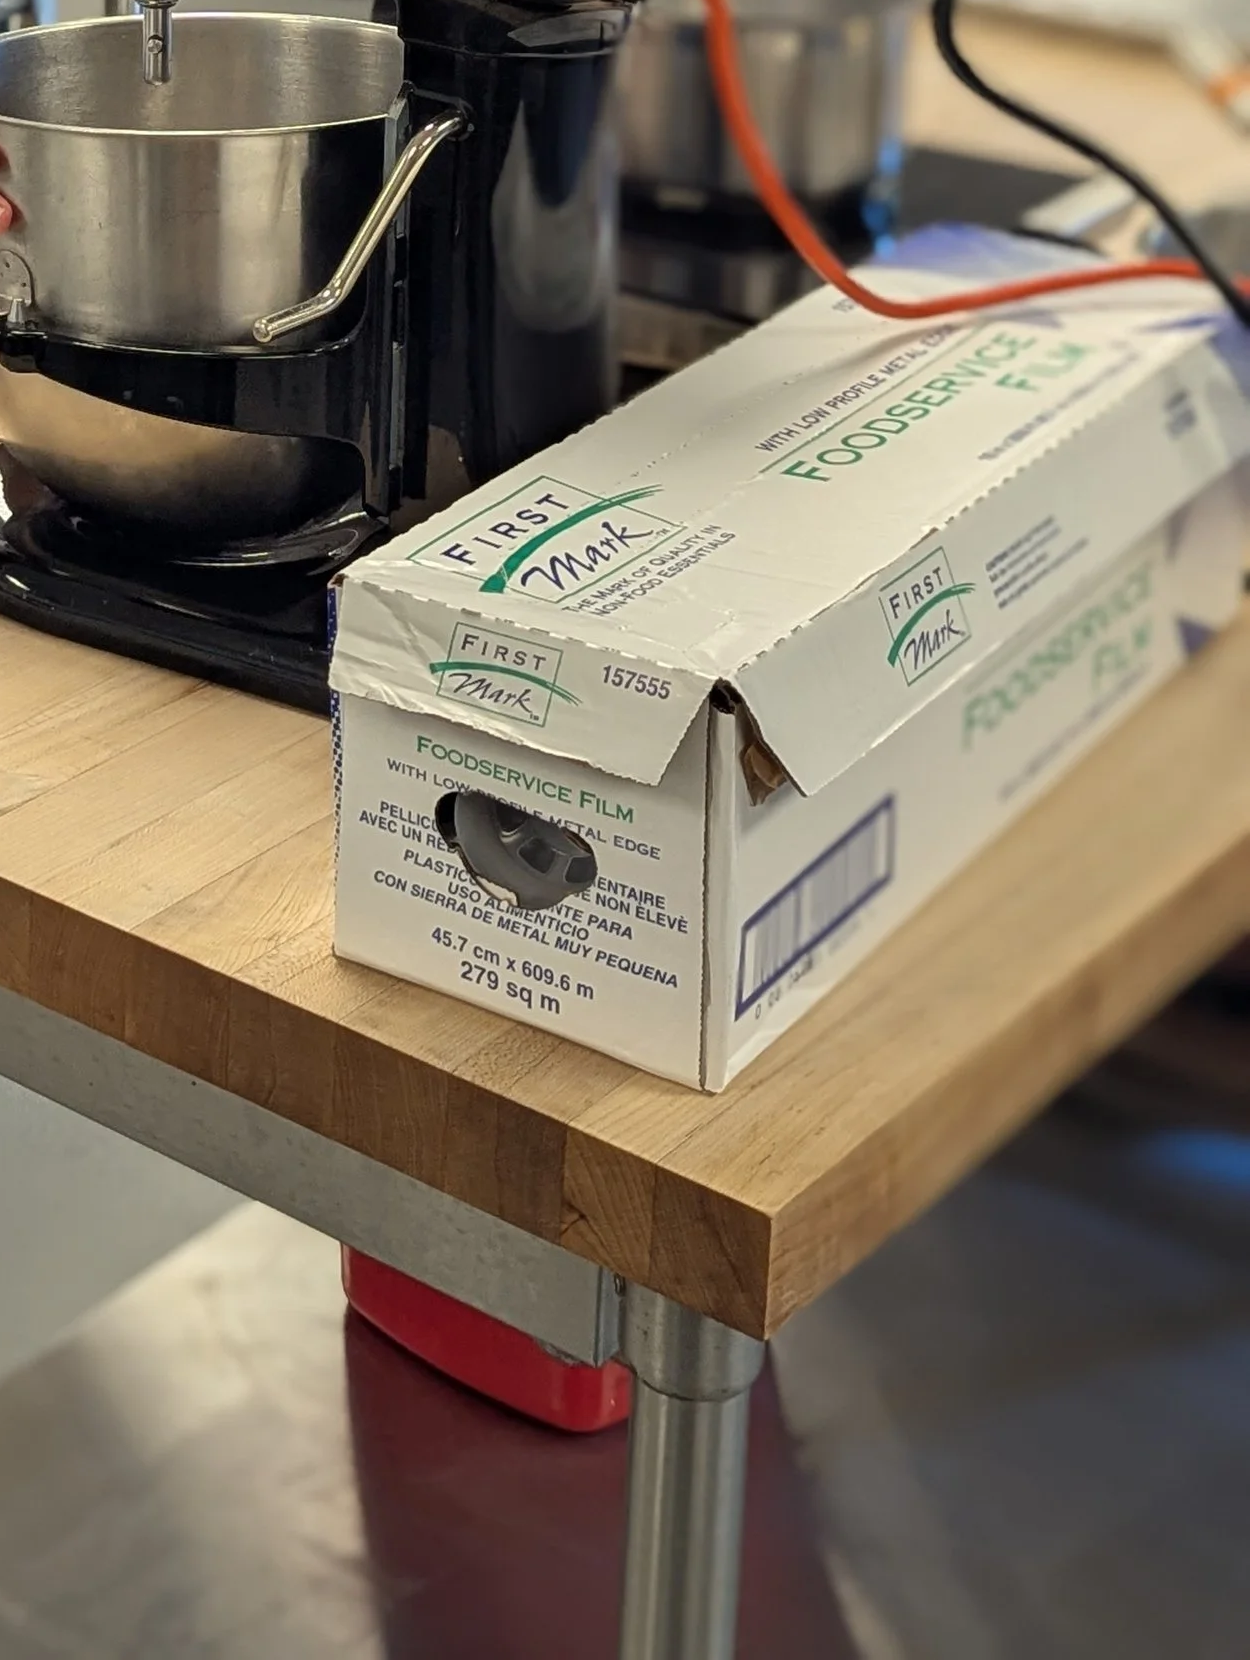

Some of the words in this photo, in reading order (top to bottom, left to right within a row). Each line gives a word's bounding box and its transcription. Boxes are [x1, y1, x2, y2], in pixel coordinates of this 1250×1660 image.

[754, 427, 801, 453] WITH
[792, 406, 822, 430] LOW
[825, 374, 887, 410] PROFILE
[879, 348, 929, 377] METAL
[780, 334, 1037, 482] FOODSERVICE
[440, 493, 569, 566] FIRST
[520, 521, 654, 591] Mark
[562, 597, 596, 613] THE
[590, 576, 635, 604] MARK
[631, 565, 652, 578] OF
[649, 534, 702, 567] QUALITY
[701, 524, 722, 535] IN
[592, 577, 664, 617] NON-FOOD
[658, 532, 736, 579] ESSENTIALS
[889, 566, 943, 619] FIRST
[461, 634, 546, 671] FIRST
[904, 609, 961, 670] Mark
[448, 673, 533, 714] Mark
[603, 664, 672, 700] 157555
[387, 758, 427, 782] WITH
[613, 836, 661, 860] EDGE
[417, 735, 572, 804] FOODSERVICE
[579, 790, 634, 824] FILM
[359, 810, 398, 834] AVEC
[401, 826, 422, 844] UN
[595, 893, 631, 916] NON
[592, 875, 666, 910] ENTAIRE
[374, 870, 408, 893] CON
[410, 884, 468, 916] SIERRA
[471, 907, 493, 925] DE
[497, 916, 551, 946] METAL
[554, 936, 594, 960] MUY
[595, 950, 679, 989] PEQUENA
[447, 882, 482, 903] USO
[484, 895, 590, 942] ALIMENTICIO
[550, 904, 585, 923] NTE
[587, 914, 633, 940] PARA
[431, 927, 469, 953] 45.7
[473, 945, 501, 967] cm
[506, 956, 517, 973] x
[521, 960, 572, 993] 609.6
[576, 982, 595, 1001] m
[460, 960, 500, 991] 279
[506, 981, 534, 1010] sq
[540, 993, 562, 1015] m
